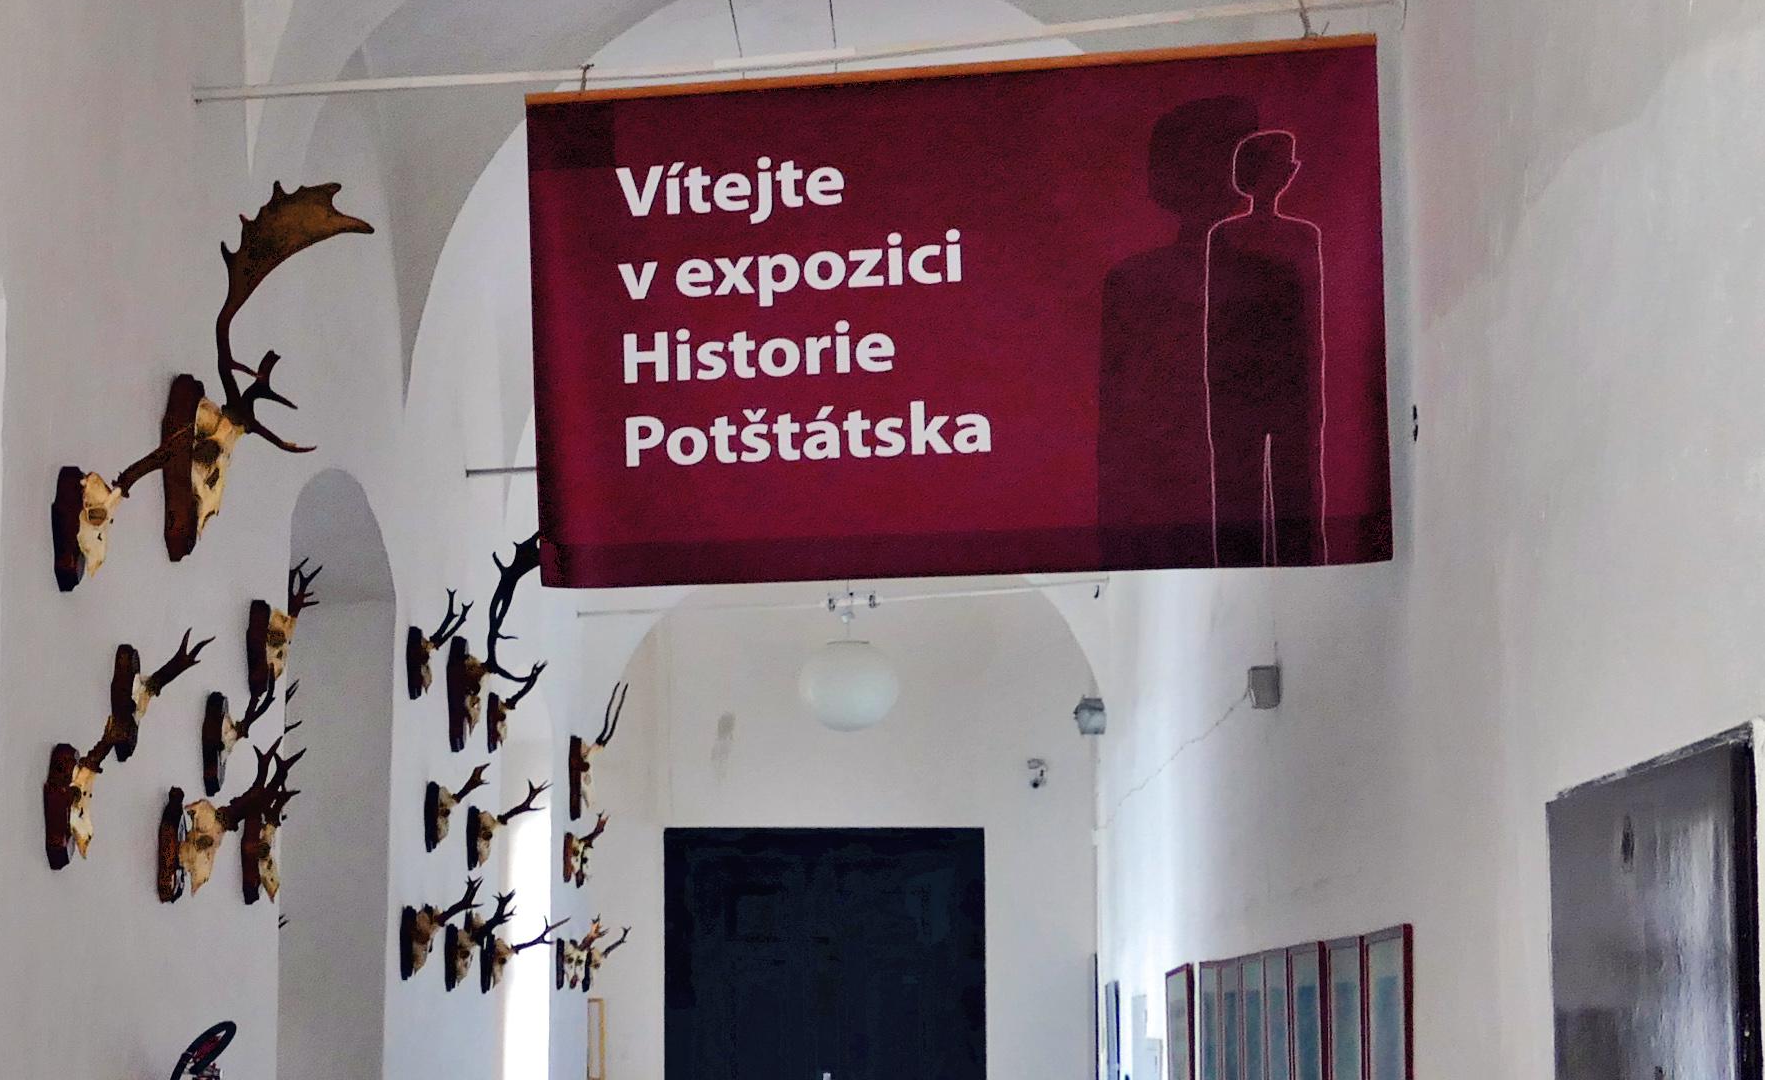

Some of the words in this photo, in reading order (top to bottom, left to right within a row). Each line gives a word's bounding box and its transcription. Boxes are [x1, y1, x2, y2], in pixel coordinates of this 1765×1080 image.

[615, 156, 845, 225] Vítejte
[617, 261, 658, 300] v
[675, 228, 962, 307] expozici
[623, 320, 896, 384] Historie
[625, 400, 992, 468] Potštátska
